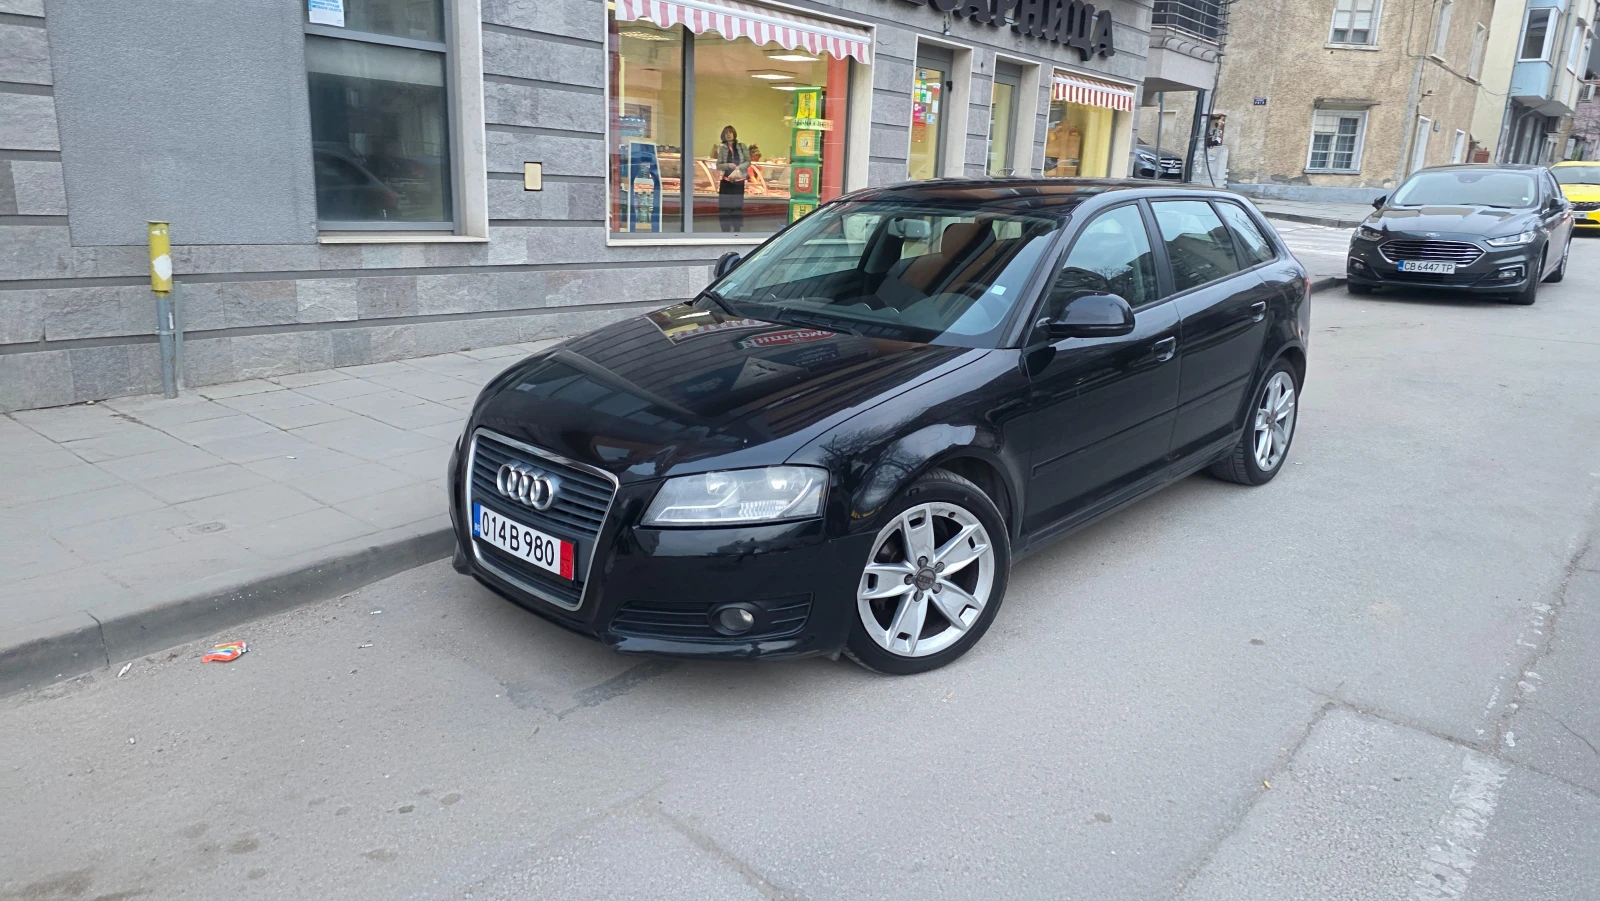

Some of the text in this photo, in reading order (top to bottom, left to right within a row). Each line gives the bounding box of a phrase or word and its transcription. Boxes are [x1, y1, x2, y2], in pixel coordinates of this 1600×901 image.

[908, 0, 1115, 61] АРНИЦА
[1404, 262, 1454, 272] CB 6447 TP
